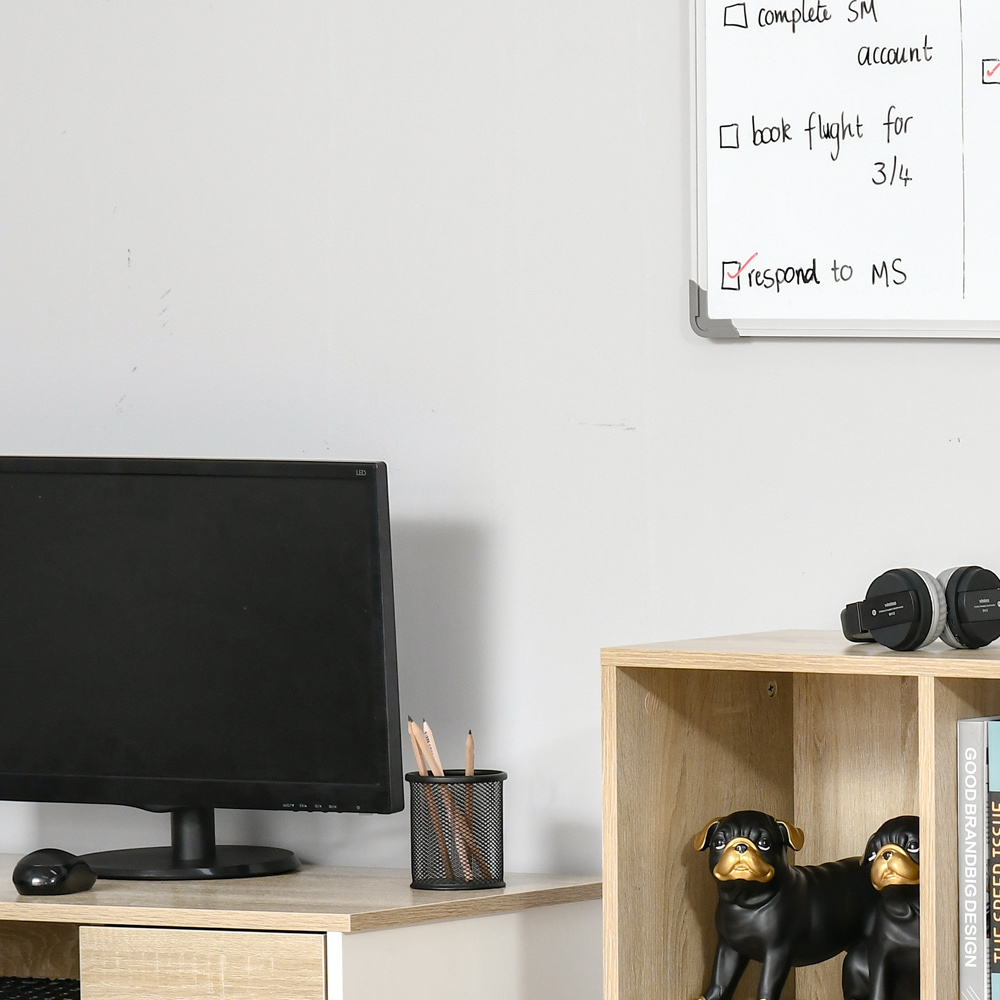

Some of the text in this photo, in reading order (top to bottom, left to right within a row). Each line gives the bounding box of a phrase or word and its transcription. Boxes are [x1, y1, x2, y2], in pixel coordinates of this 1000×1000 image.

[758, 0, 878, 33] complete SM
[857, 35, 934, 66] account
[752, 115, 793, 147] book
[883, 105, 914, 144] for
[871, 155, 913, 187] 3/4
[748, 258, 907, 293] respond to MS
[964, 747, 978, 801] GOOD
[964, 900, 977, 968] DESIGN
